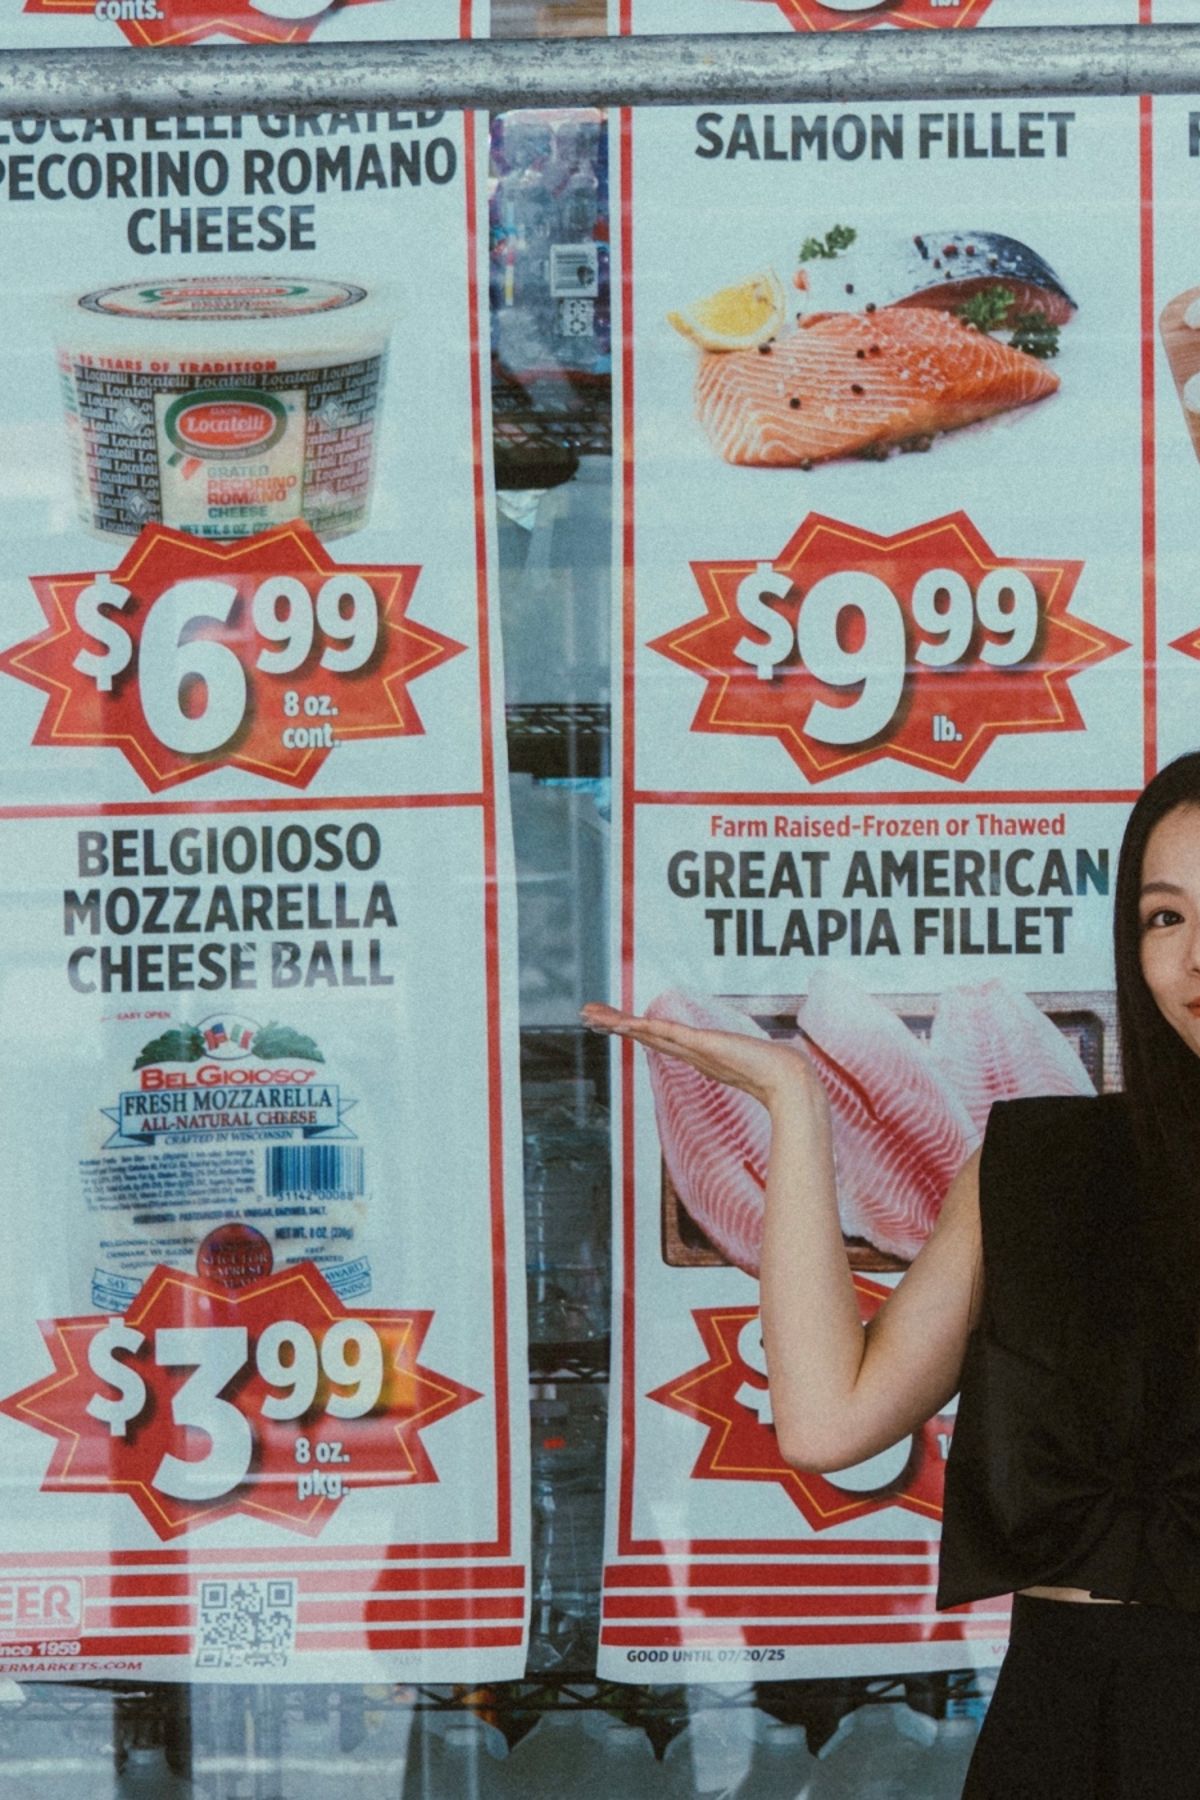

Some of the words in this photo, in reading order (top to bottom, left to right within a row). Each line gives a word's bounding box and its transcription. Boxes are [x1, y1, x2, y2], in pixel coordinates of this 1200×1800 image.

[694, 112, 904, 161] SALMON
[918, 111, 1076, 159] FILLET
[0, 149, 229, 200] ECORINO
[244, 136, 457, 195] ROMANO
[127, 204, 317, 255] CHEESE
[149, 360, 171, 373] OF
[178, 360, 279, 373] TRADITION
[186, 414, 266, 434] Locatelli
[207, 490, 287, 505] ROMANO
[207, 506, 269, 518] CHEESE
[283, 691, 300, 717] 8
[303, 695, 339, 717] oz.
[282, 723, 342, 750] cont.
[931, 714, 963, 742] lb.
[710, 816, 768, 838] Farm
[773, 815, 939, 838] Raised-Frozen
[945, 819, 970, 836] or
[975, 813, 1066, 836] Thawed
[77, 822, 381, 878] BELGIOIOSO
[666, 850, 830, 899] GREAT
[842, 848, 1110, 898] AMERICAN
[62, 880, 399, 937] MOZZARELLA
[705, 908, 901, 957] TILAPIA
[913, 906, 1074, 956] FILLET
[67, 941, 257, 994] CHEESE
[269, 938, 395, 989] BALL
[143, 1010, 171, 1020] OPEN
[124, 1092, 188, 1116] FRESH
[193, 1087, 333, 1112] MOZZARELLA
[140, 1113, 253, 1133] ALL-NATURAL
[256, 1110, 318, 1126] CHEESE
[216, 1132, 229, 1142] IN
[231, 1130, 294, 1142] WISCONSIN
[294, 1437, 311, 1463] 8
[315, 1440, 351, 1463] oz.
[296, 1470, 351, 1500] pkg.
[37, 1640, 82, 1656] 1959
[626, 1649, 669, 1663] GOOD
[672, 1649, 713, 1662] UNTIL
[717, 1647, 786, 1663] 07/20/25
